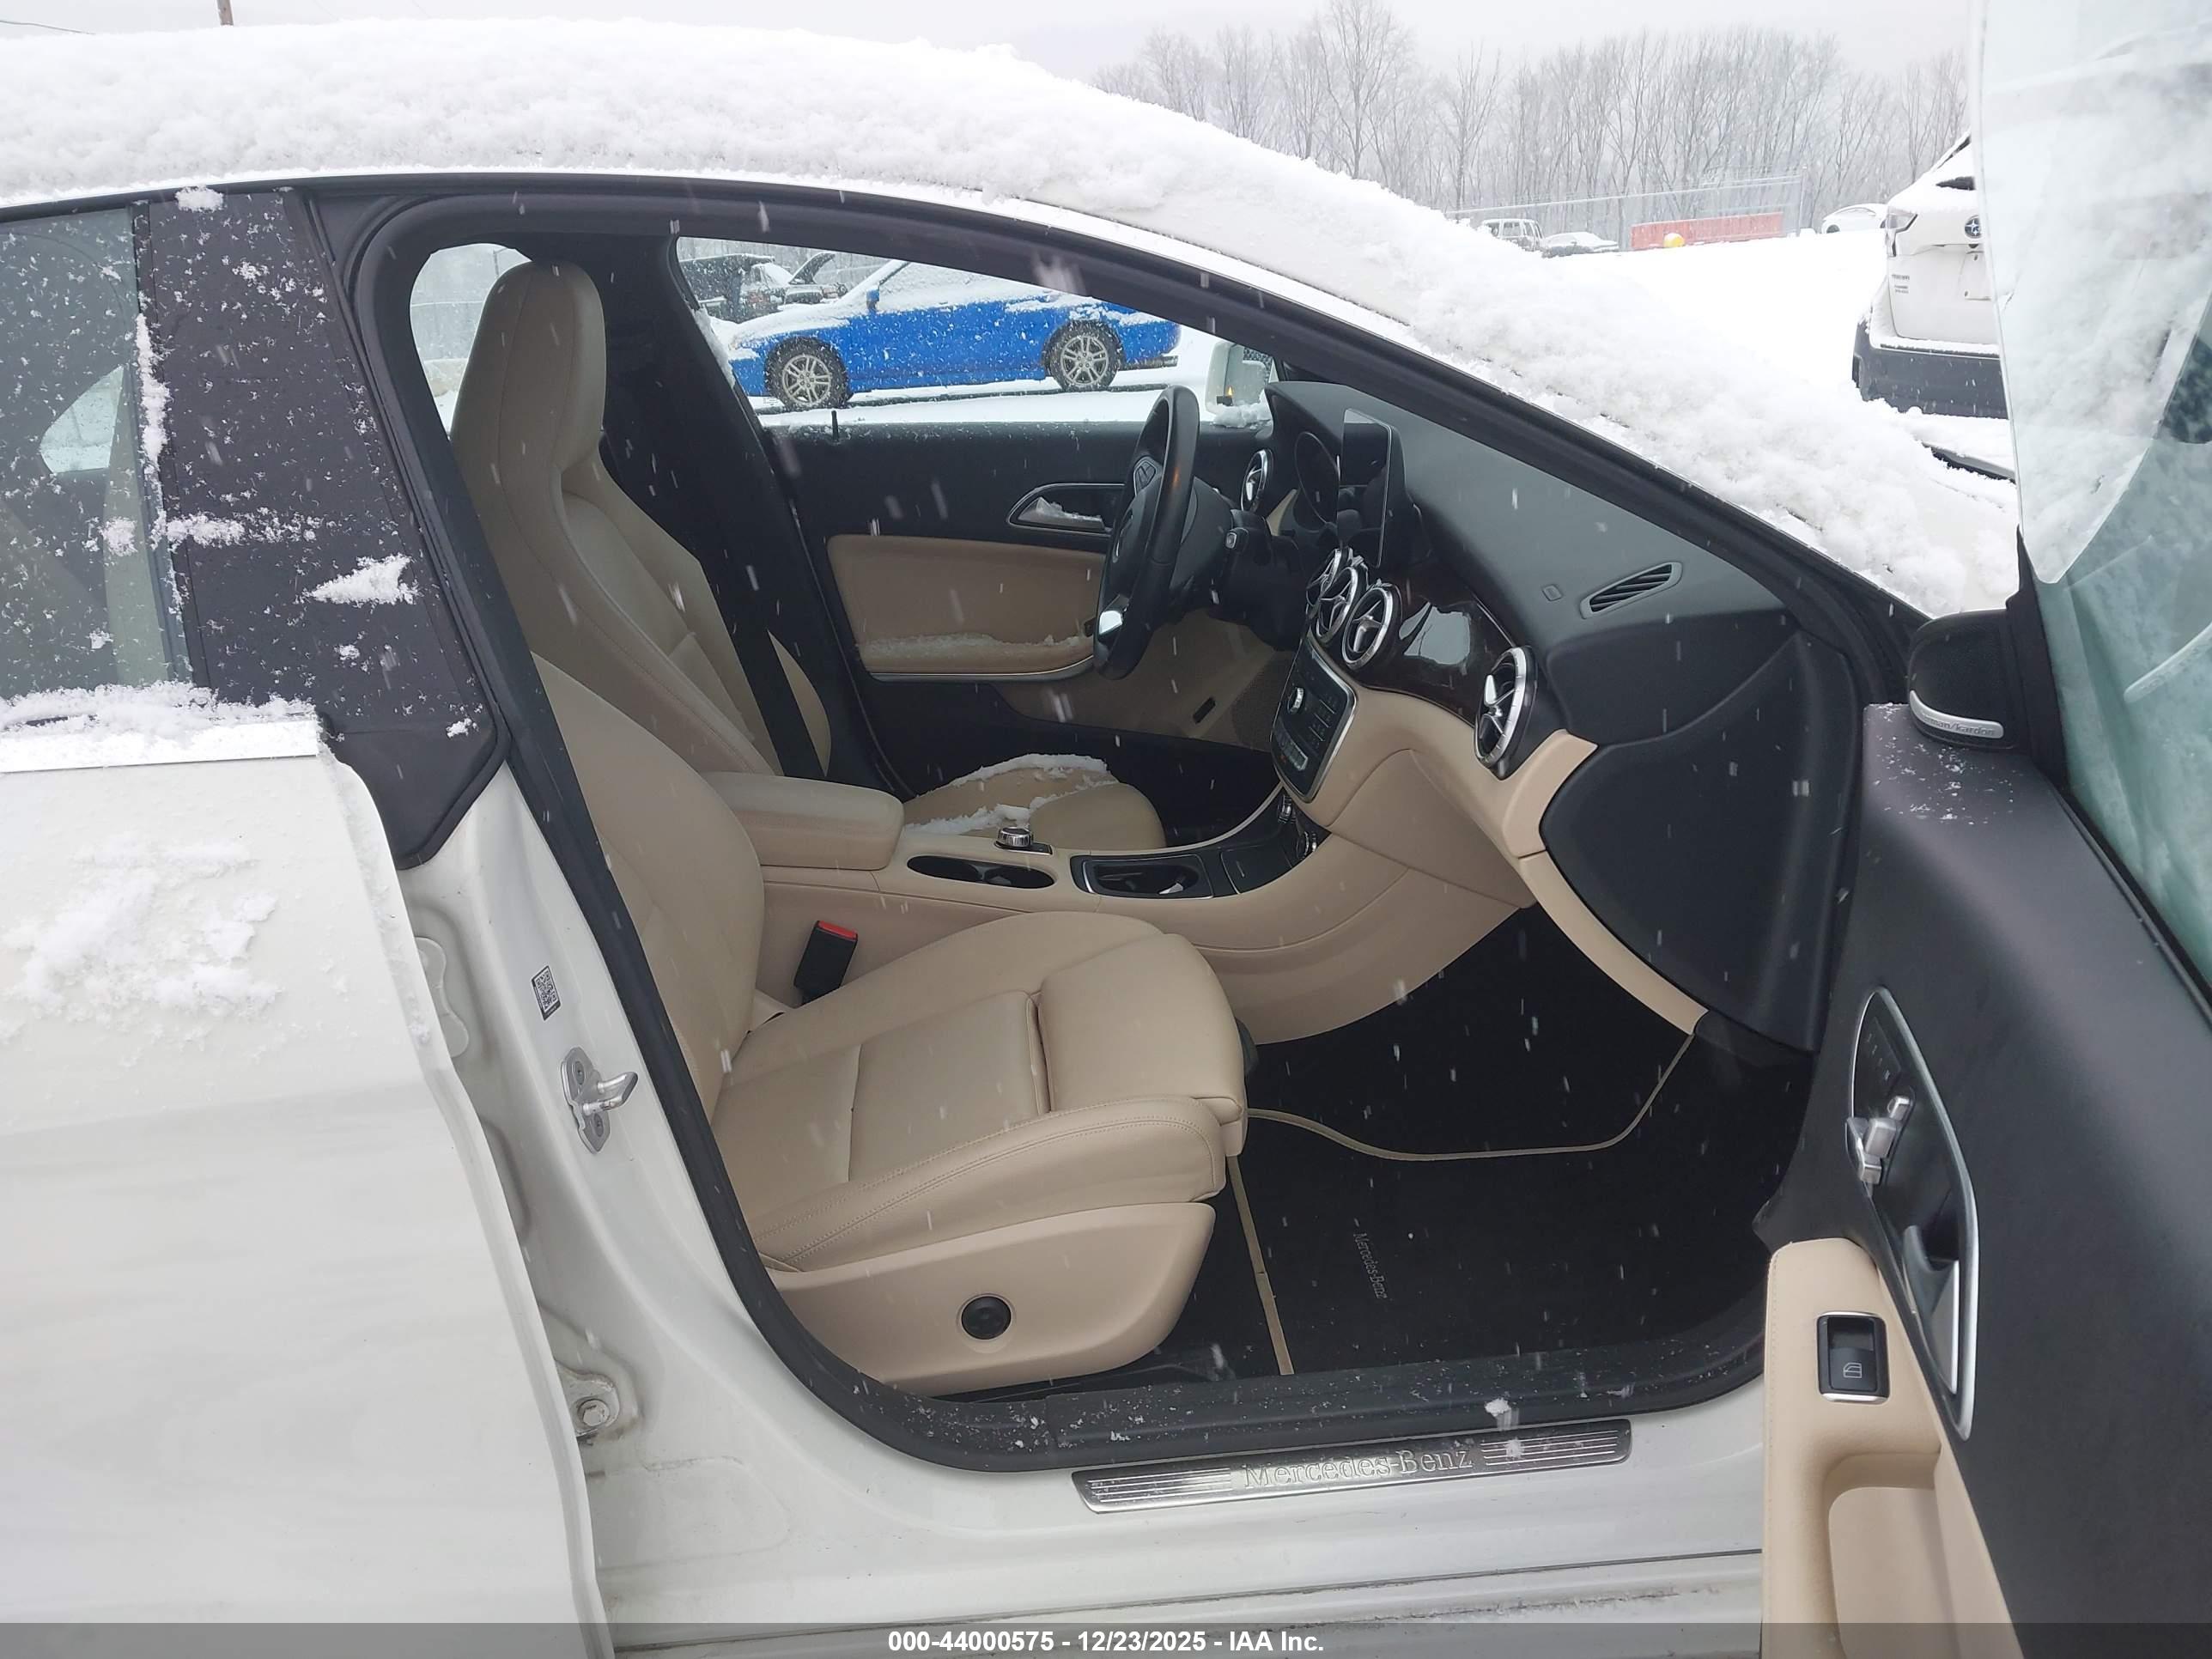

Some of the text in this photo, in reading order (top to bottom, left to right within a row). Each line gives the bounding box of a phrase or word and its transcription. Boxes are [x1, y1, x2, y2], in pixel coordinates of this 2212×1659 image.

[1921, 711, 1996, 736] rman/kardon
[1353, 1233, 1388, 1298] Mercedes-Benz
[1240, 1449, 1474, 1489] Mercedes-Benz
